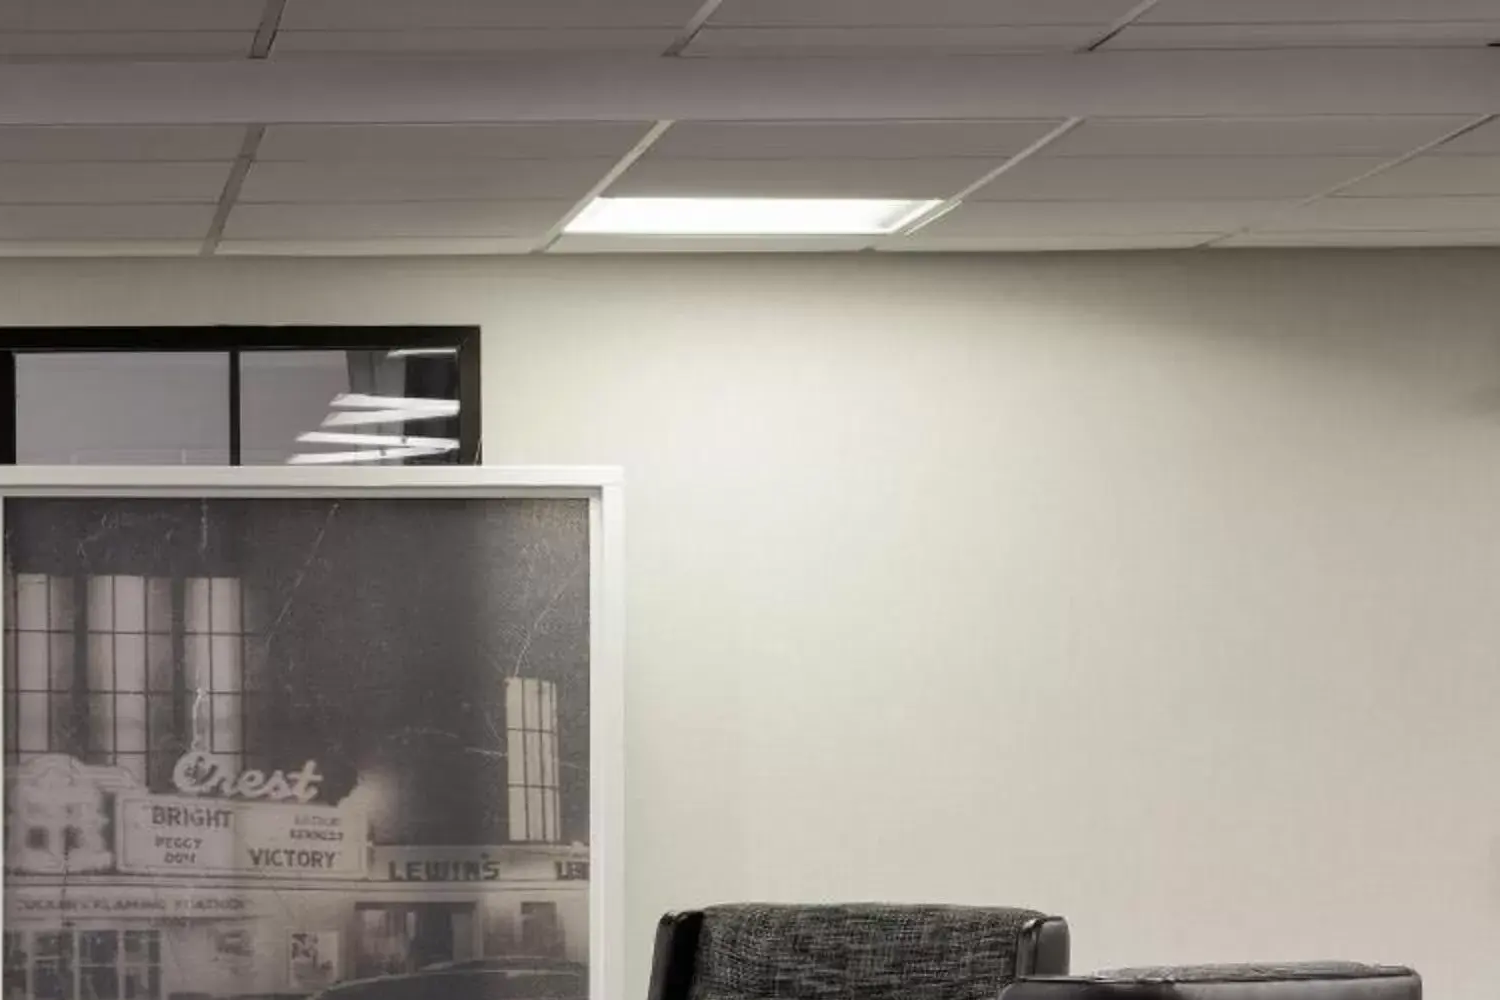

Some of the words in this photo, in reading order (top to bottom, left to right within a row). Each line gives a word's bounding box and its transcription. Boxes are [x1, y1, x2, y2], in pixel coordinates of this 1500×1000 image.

[173, 751, 323, 802] Crest
[151, 806, 233, 828] BRIGHT
[249, 849, 337, 869] VICTORY
